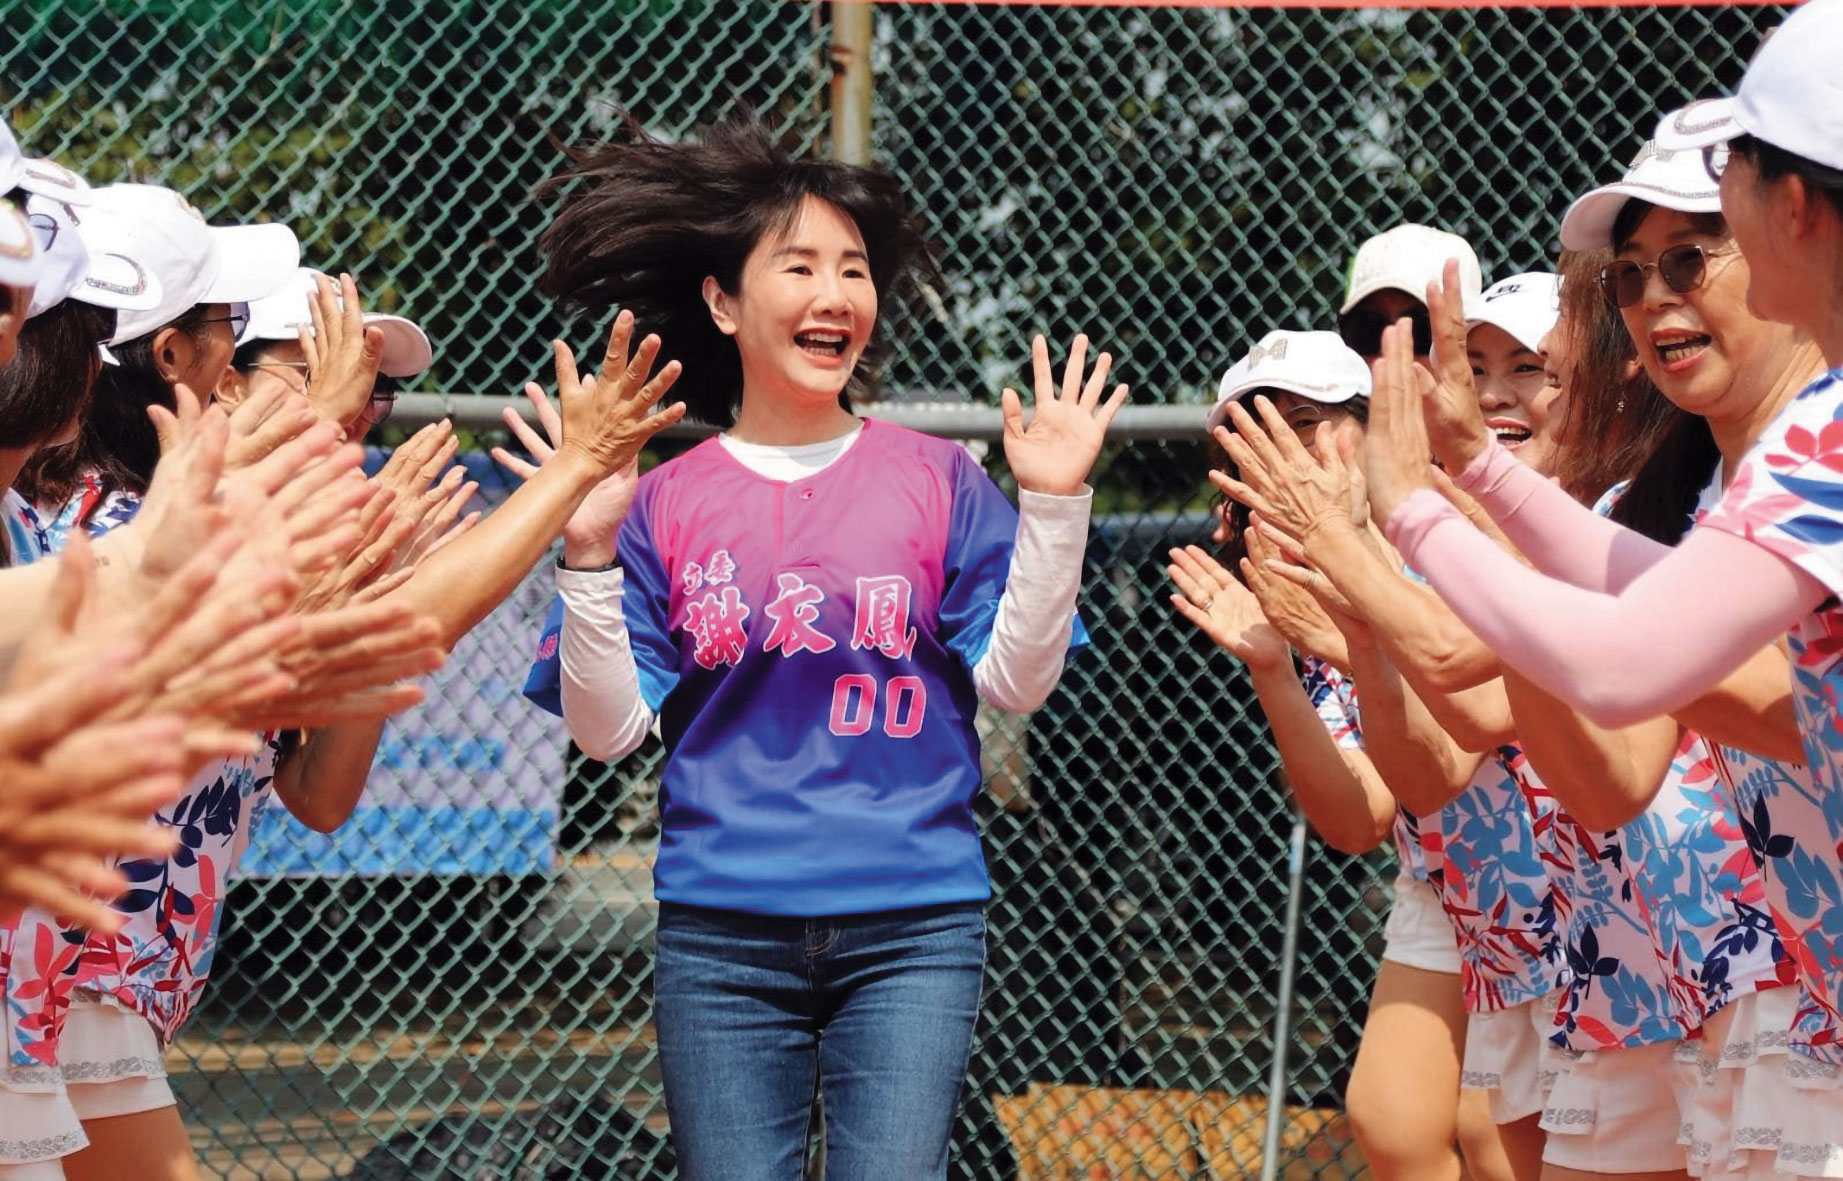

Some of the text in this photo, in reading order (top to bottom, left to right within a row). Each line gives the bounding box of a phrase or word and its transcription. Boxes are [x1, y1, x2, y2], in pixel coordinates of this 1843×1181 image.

[683, 573, 917, 670] 謝衣鳳
[829, 674, 926, 738] 00
